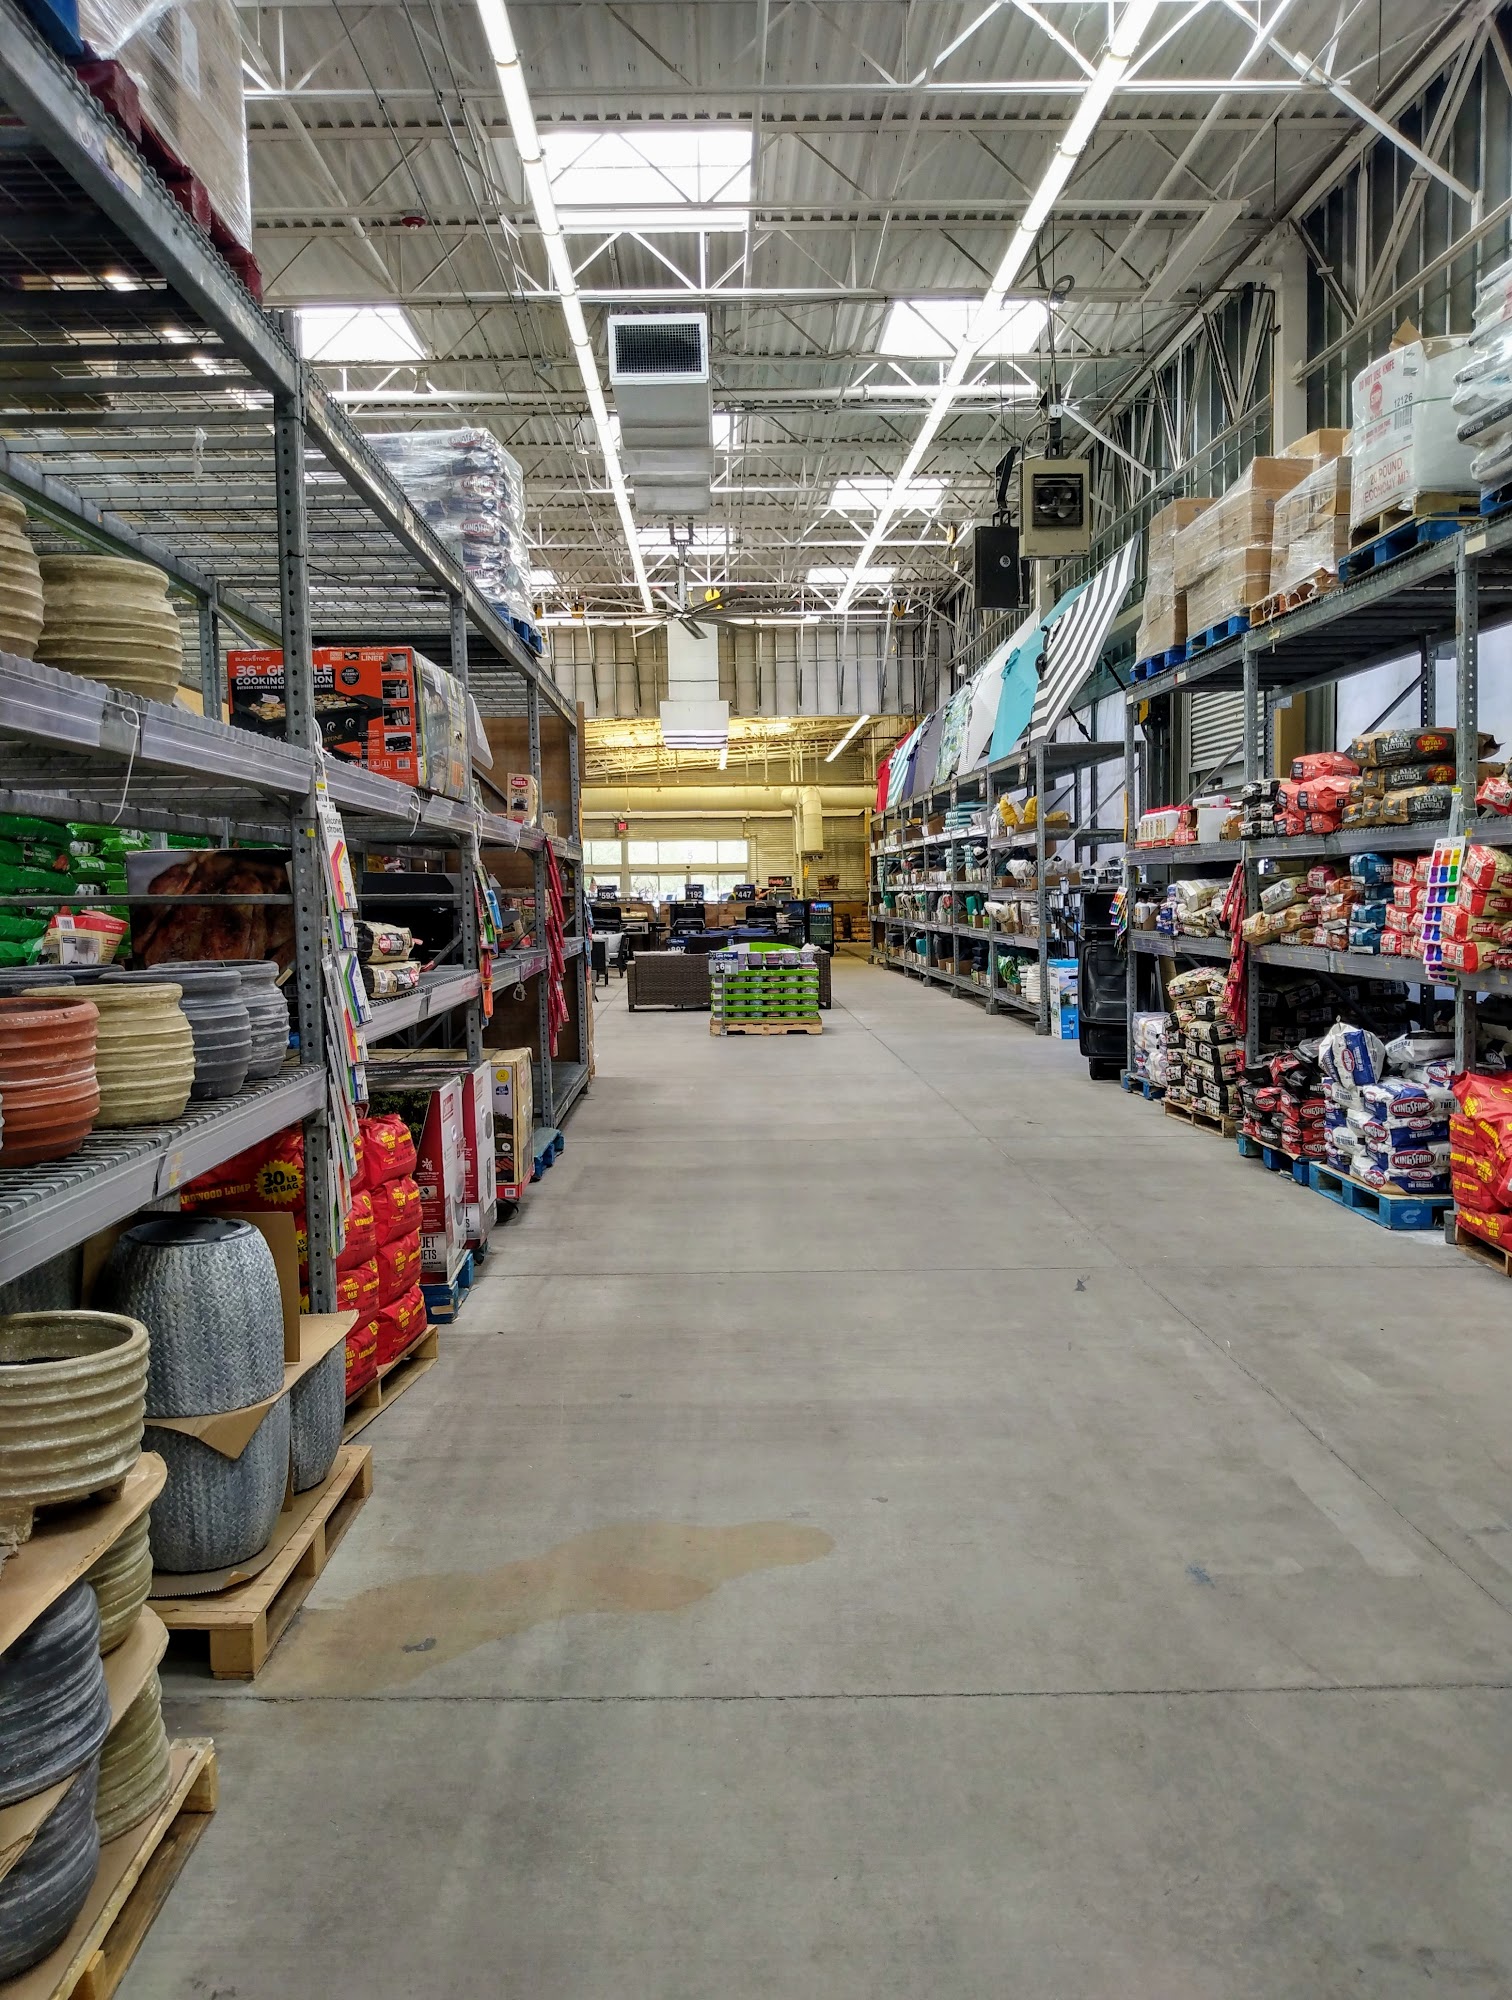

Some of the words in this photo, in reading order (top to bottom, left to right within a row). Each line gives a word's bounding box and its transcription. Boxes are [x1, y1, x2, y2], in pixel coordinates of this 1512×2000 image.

[1373, 367, 1382, 381] USE
[1382, 359, 1395, 375] KNIFE
[1394, 392, 1413, 408] 12126
[1463, 420, 1485, 436] MORTON
[1378, 457, 1403, 480] POUND
[1364, 476, 1396, 504] ECONOMY
[236, 665, 261, 676] 36"
[236, 677, 285, 686] COOKING
[1382, 740, 1412, 753] NATURAL
[1390, 772, 1422, 783] NATURAL
[1414, 800, 1445, 811] NATURAL
[327, 825, 342, 834] straws
[1303, 1107, 1325, 1116] KINGSFO
[1395, 1154, 1432, 1165] KINGSFORD
[263, 1171, 285, 1187] 30
[286, 1175, 298, 1183] LB
[180, 1189, 222, 1204] ARDWOOD
[225, 1184, 251, 1196] LUMP
[264, 1186, 279, 1195] BIG
[280, 1183, 299, 1192] BAG
[421, 1236, 435, 1248] JET
